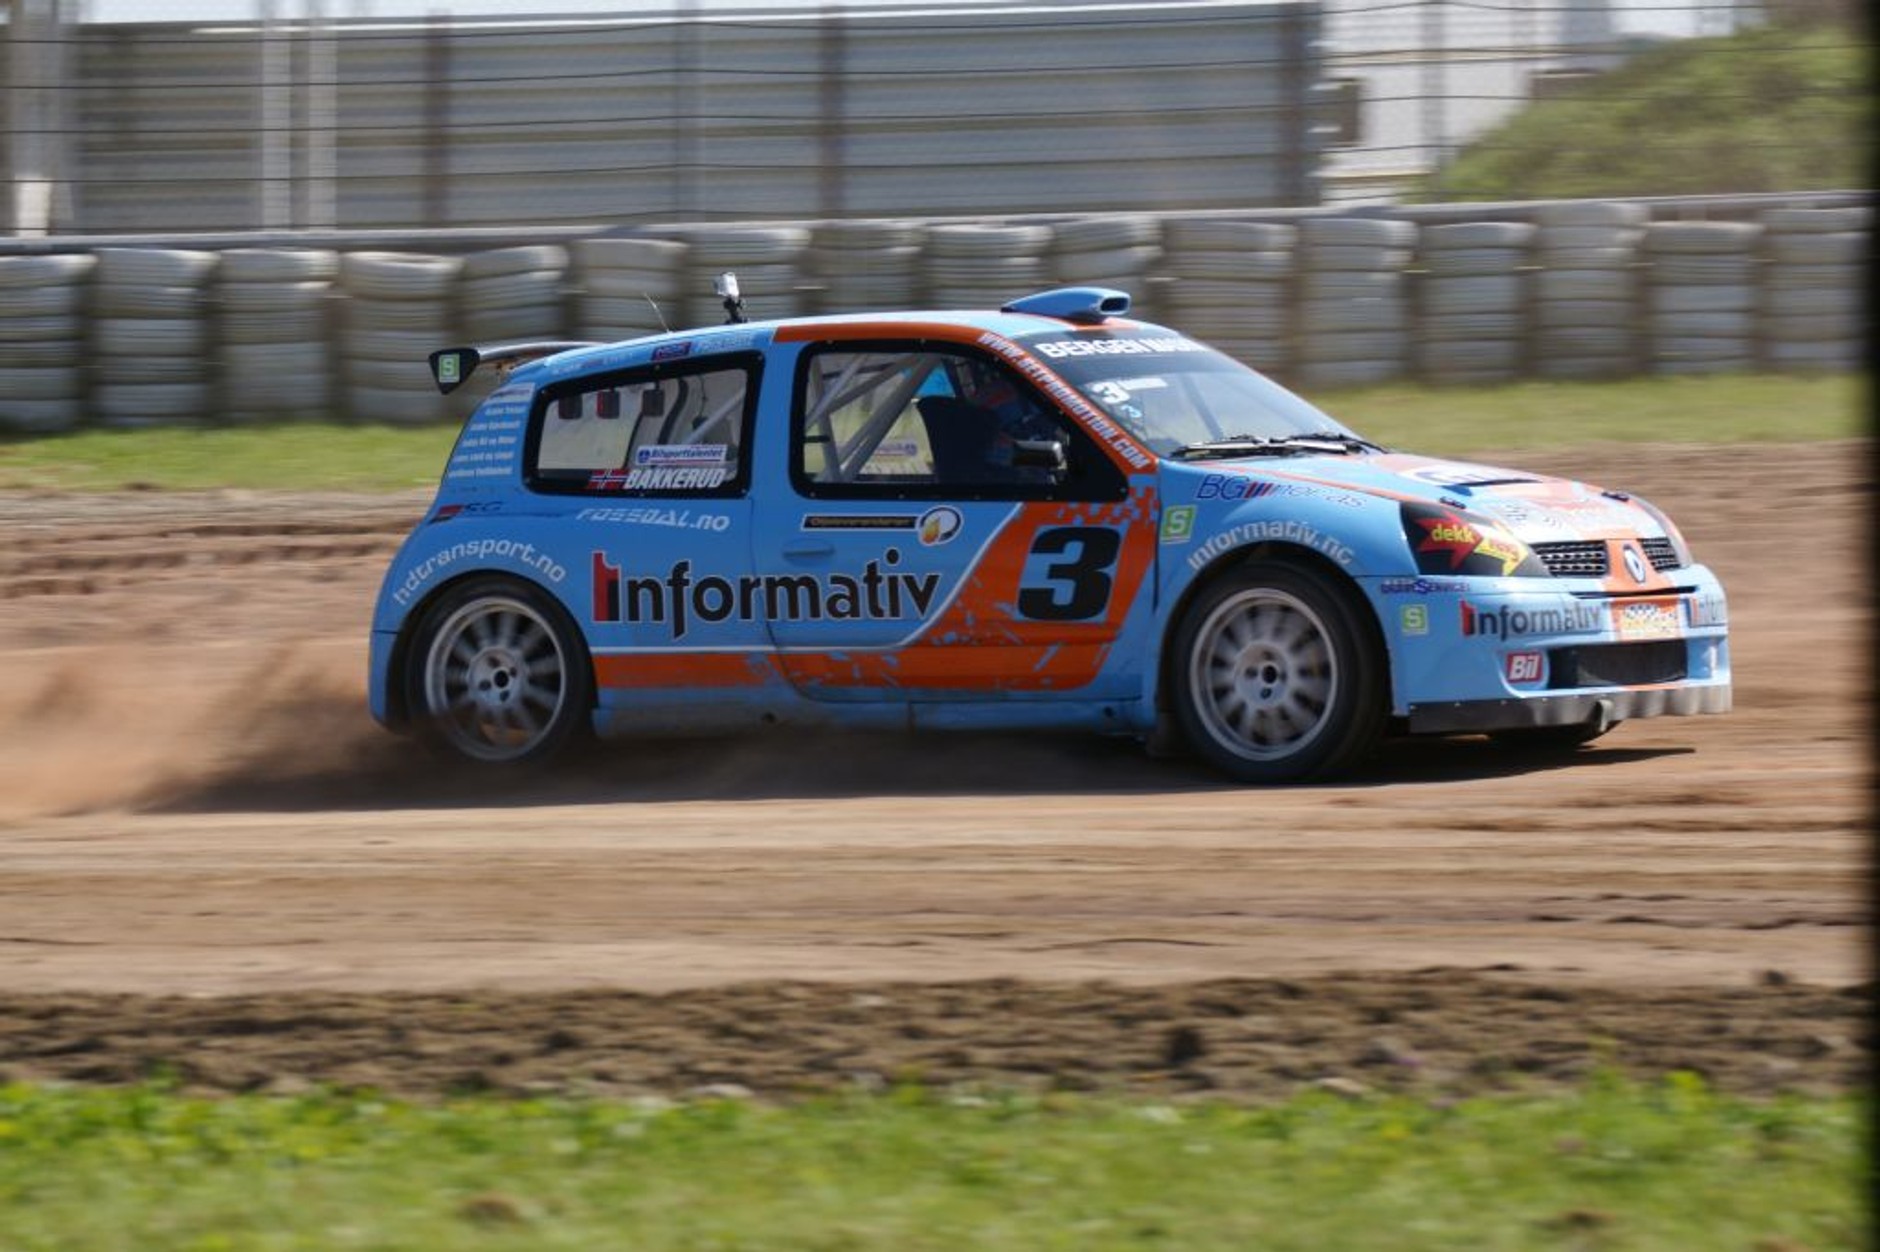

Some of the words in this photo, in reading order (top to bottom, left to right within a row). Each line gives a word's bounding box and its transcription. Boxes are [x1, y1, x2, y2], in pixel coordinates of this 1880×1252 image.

[1036, 337, 1151, 358] BERGEN
[623, 468, 727, 489] BAKKERUD
[1431, 523, 1477, 544] dekk
[1017, 526, 1121, 622] 3
[1508, 654, 1541, 680] Bil
